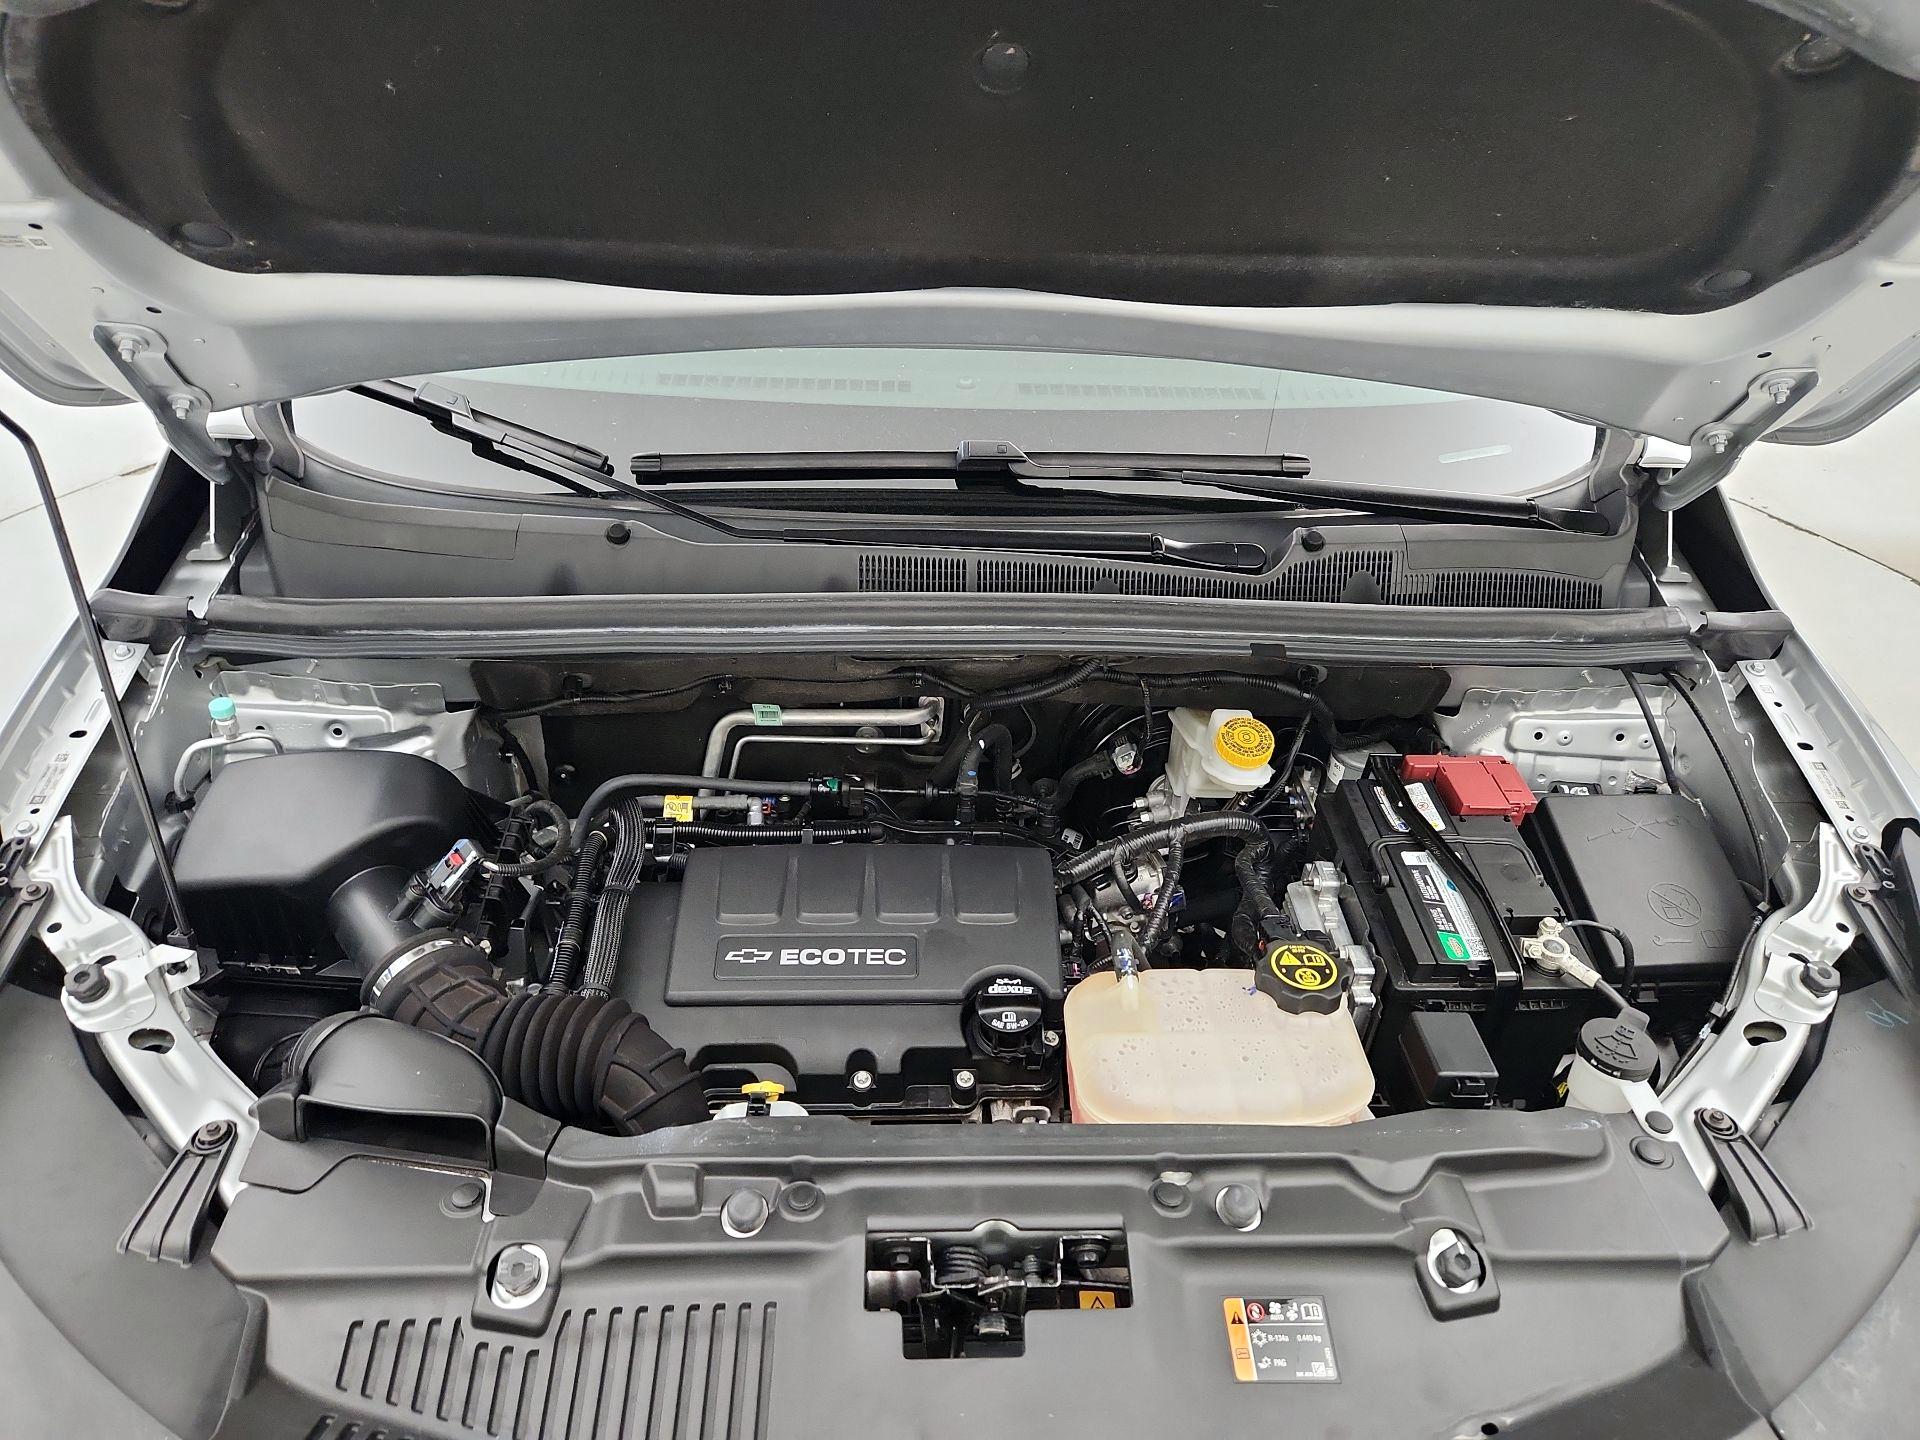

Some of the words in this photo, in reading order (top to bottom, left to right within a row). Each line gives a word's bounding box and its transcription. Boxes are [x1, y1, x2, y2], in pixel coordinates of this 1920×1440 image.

[779, 948, 907, 966] ECOTEC
[991, 1018, 1005, 1029] SAE
[1006, 1018, 1029, 1030] 5W-30
[1273, 1358, 1287, 1367] PAG
